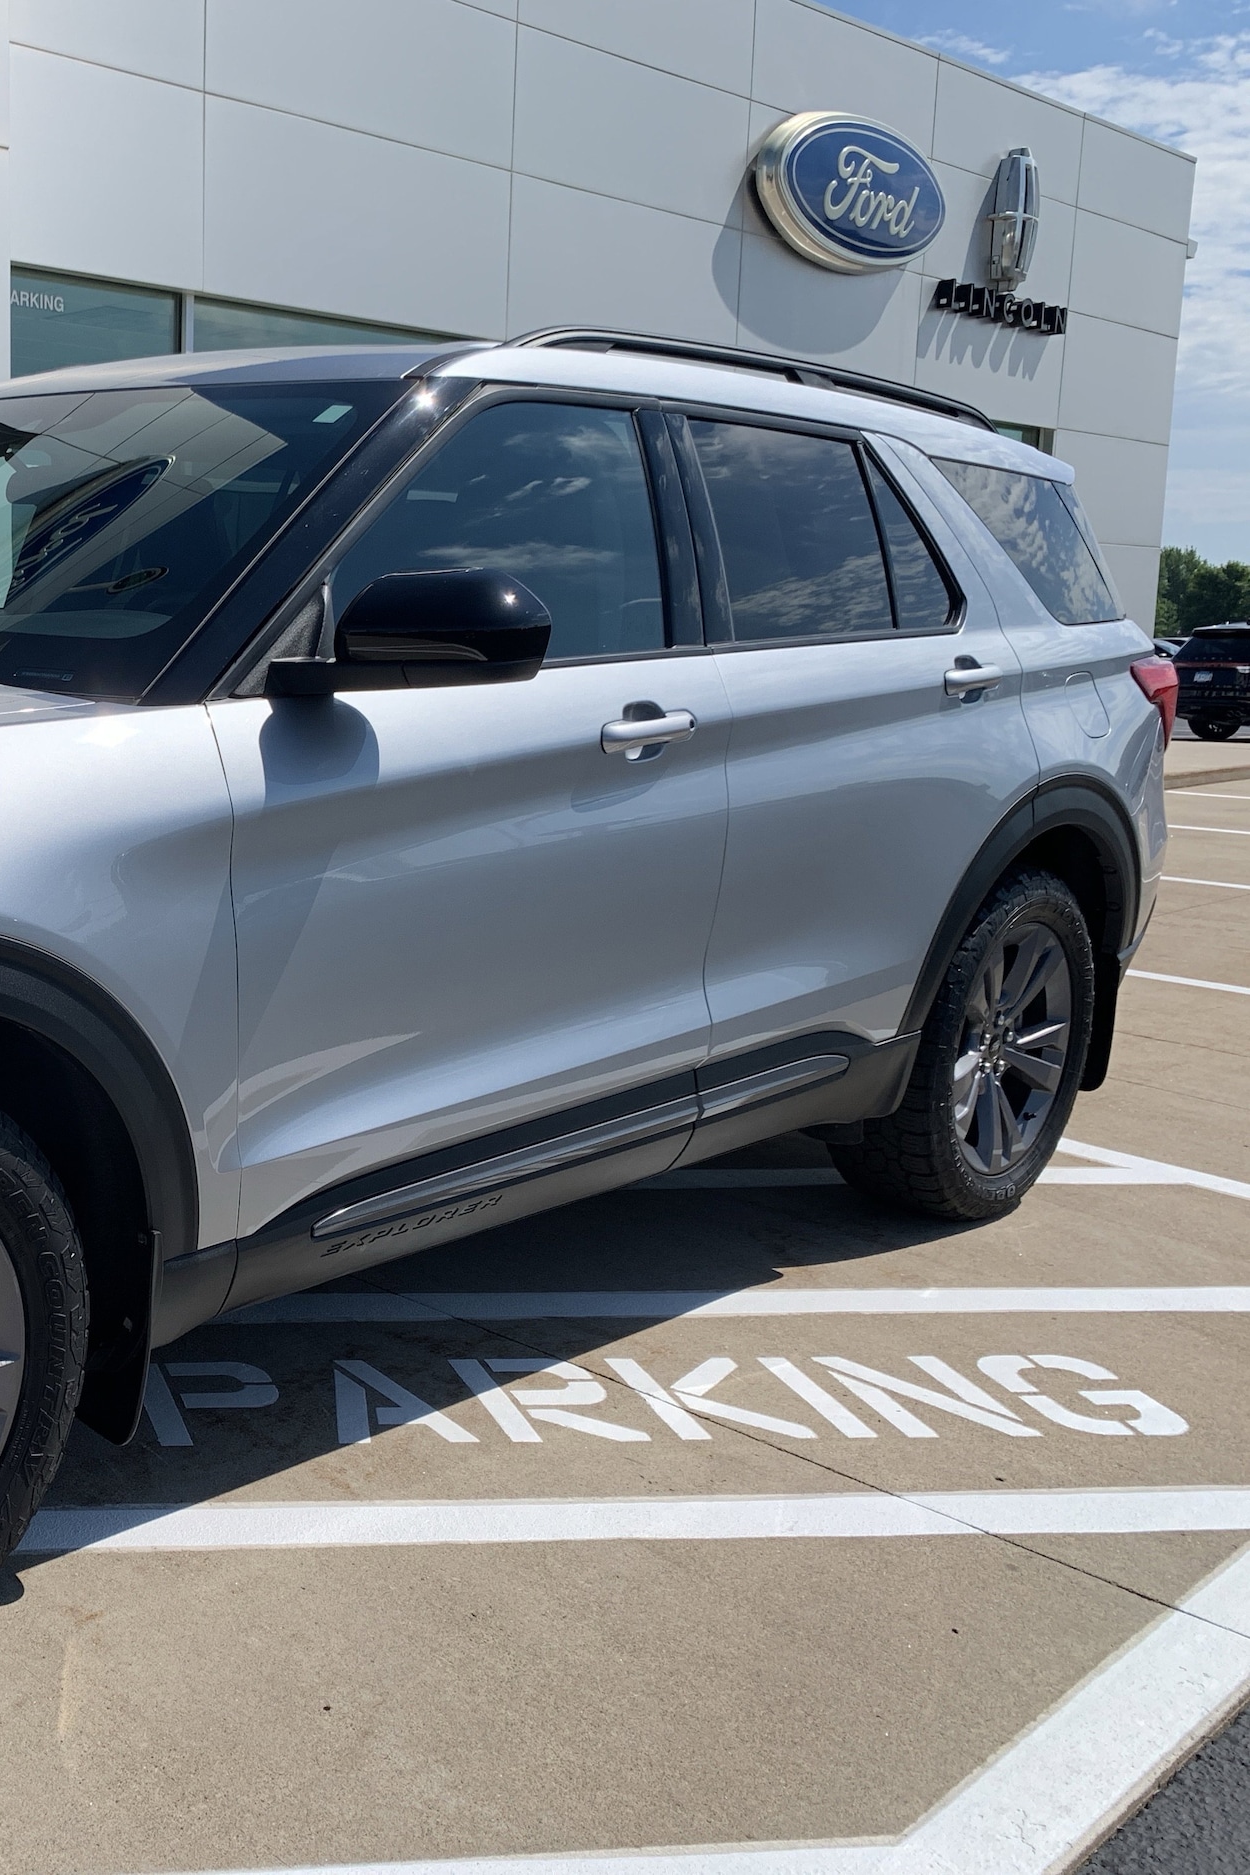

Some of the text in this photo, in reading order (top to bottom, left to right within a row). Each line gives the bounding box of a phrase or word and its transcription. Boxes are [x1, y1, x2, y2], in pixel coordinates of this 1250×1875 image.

[823, 145, 920, 239] Ford
[10, 289, 64, 312] ARKING
[937, 278, 1068, 335] LINCOLN
[320, 1195, 502, 1257] EXPLORER
[144, 1355, 1189, 1447] PARKING
